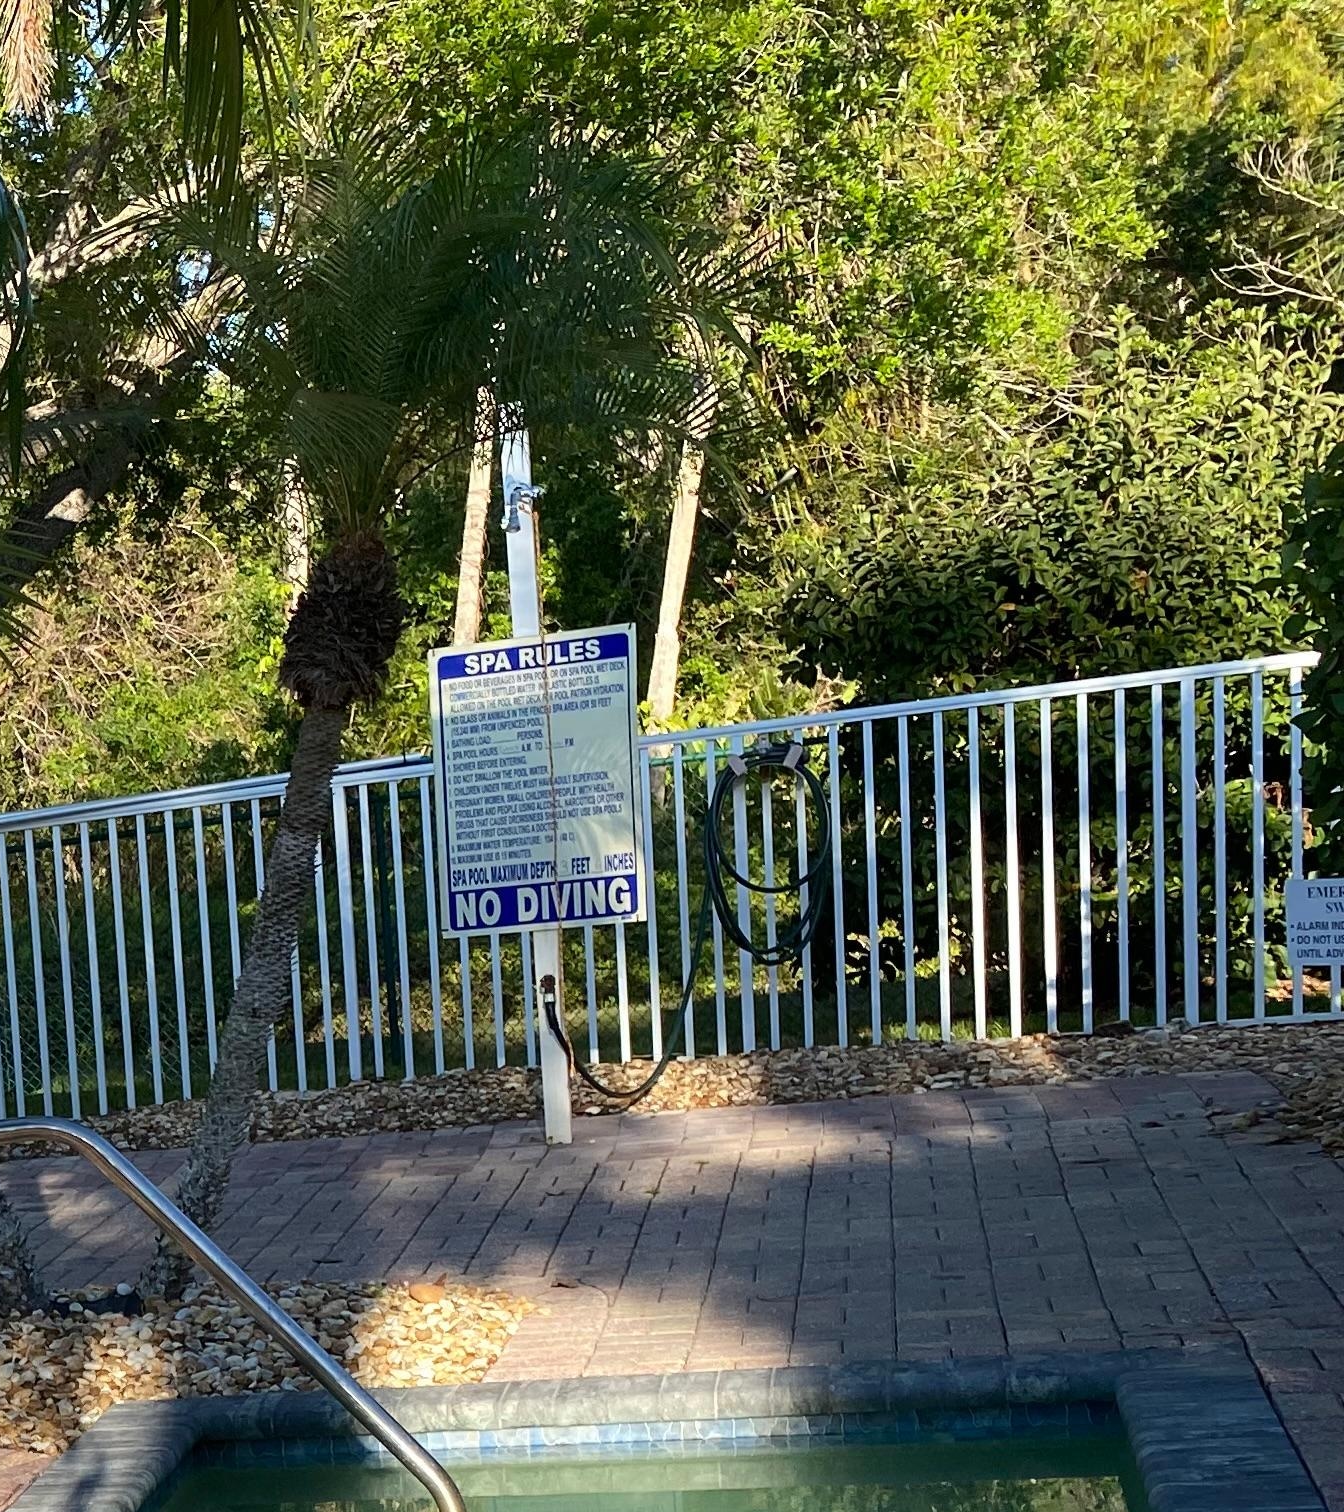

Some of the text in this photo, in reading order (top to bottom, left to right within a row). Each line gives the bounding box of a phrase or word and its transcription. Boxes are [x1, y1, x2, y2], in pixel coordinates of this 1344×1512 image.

[464, 638, 601, 675] SPA RULES
[598, 698, 611, 708] FEET
[451, 869, 466, 886] SPA
[468, 866, 489, 885] POOL
[571, 857, 590, 875] FEET
[604, 853, 633, 872] INCHES
[454, 878, 632, 928] NO DIVING
[1296, 921, 1329, 931] ALARM
[1297, 935, 1311, 944] DO
[1313, 934, 1331, 944] NOT
[1297, 949, 1324, 958] UNTIL
